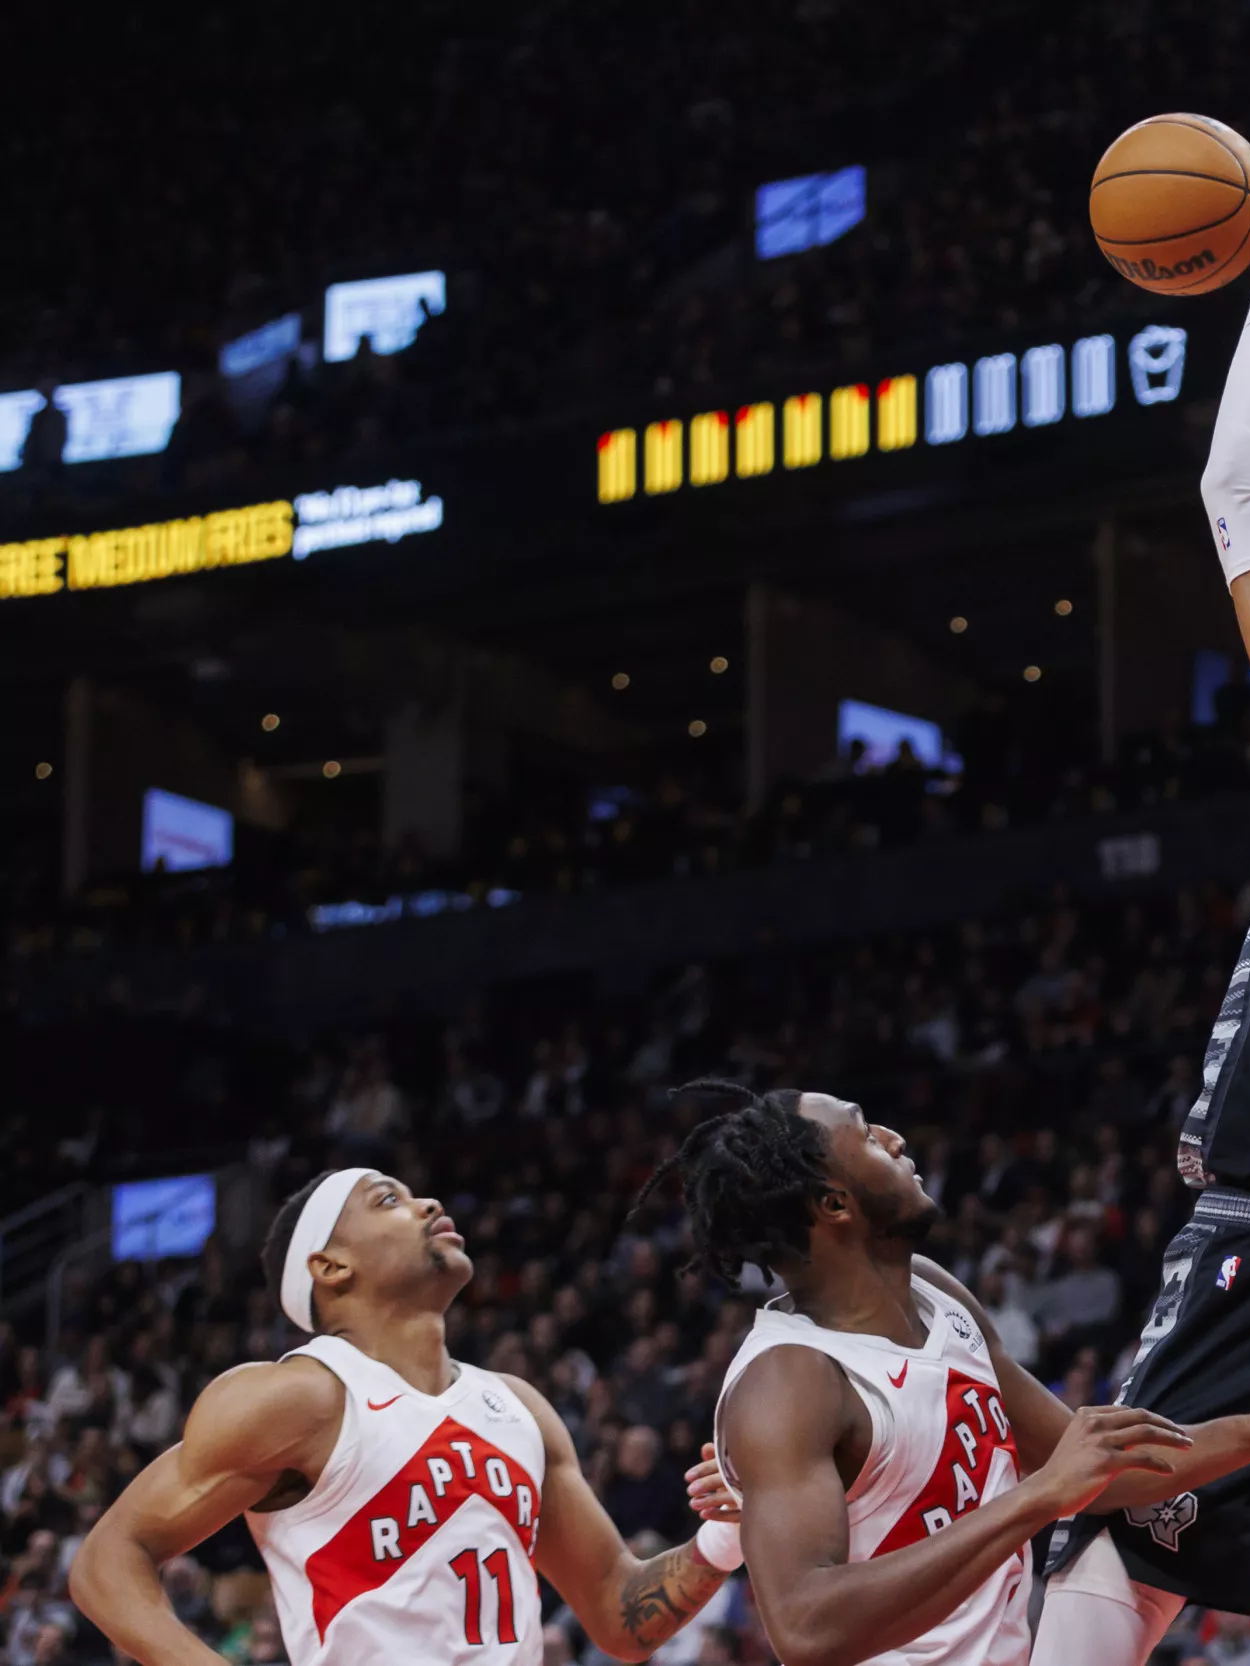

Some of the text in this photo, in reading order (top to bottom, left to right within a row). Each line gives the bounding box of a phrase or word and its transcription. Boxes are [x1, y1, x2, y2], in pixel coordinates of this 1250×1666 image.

[1104, 249, 1217, 281] Wilson
[921, 1387, 1011, 1537] RAPTO
[448, 1547, 521, 1646] 11
